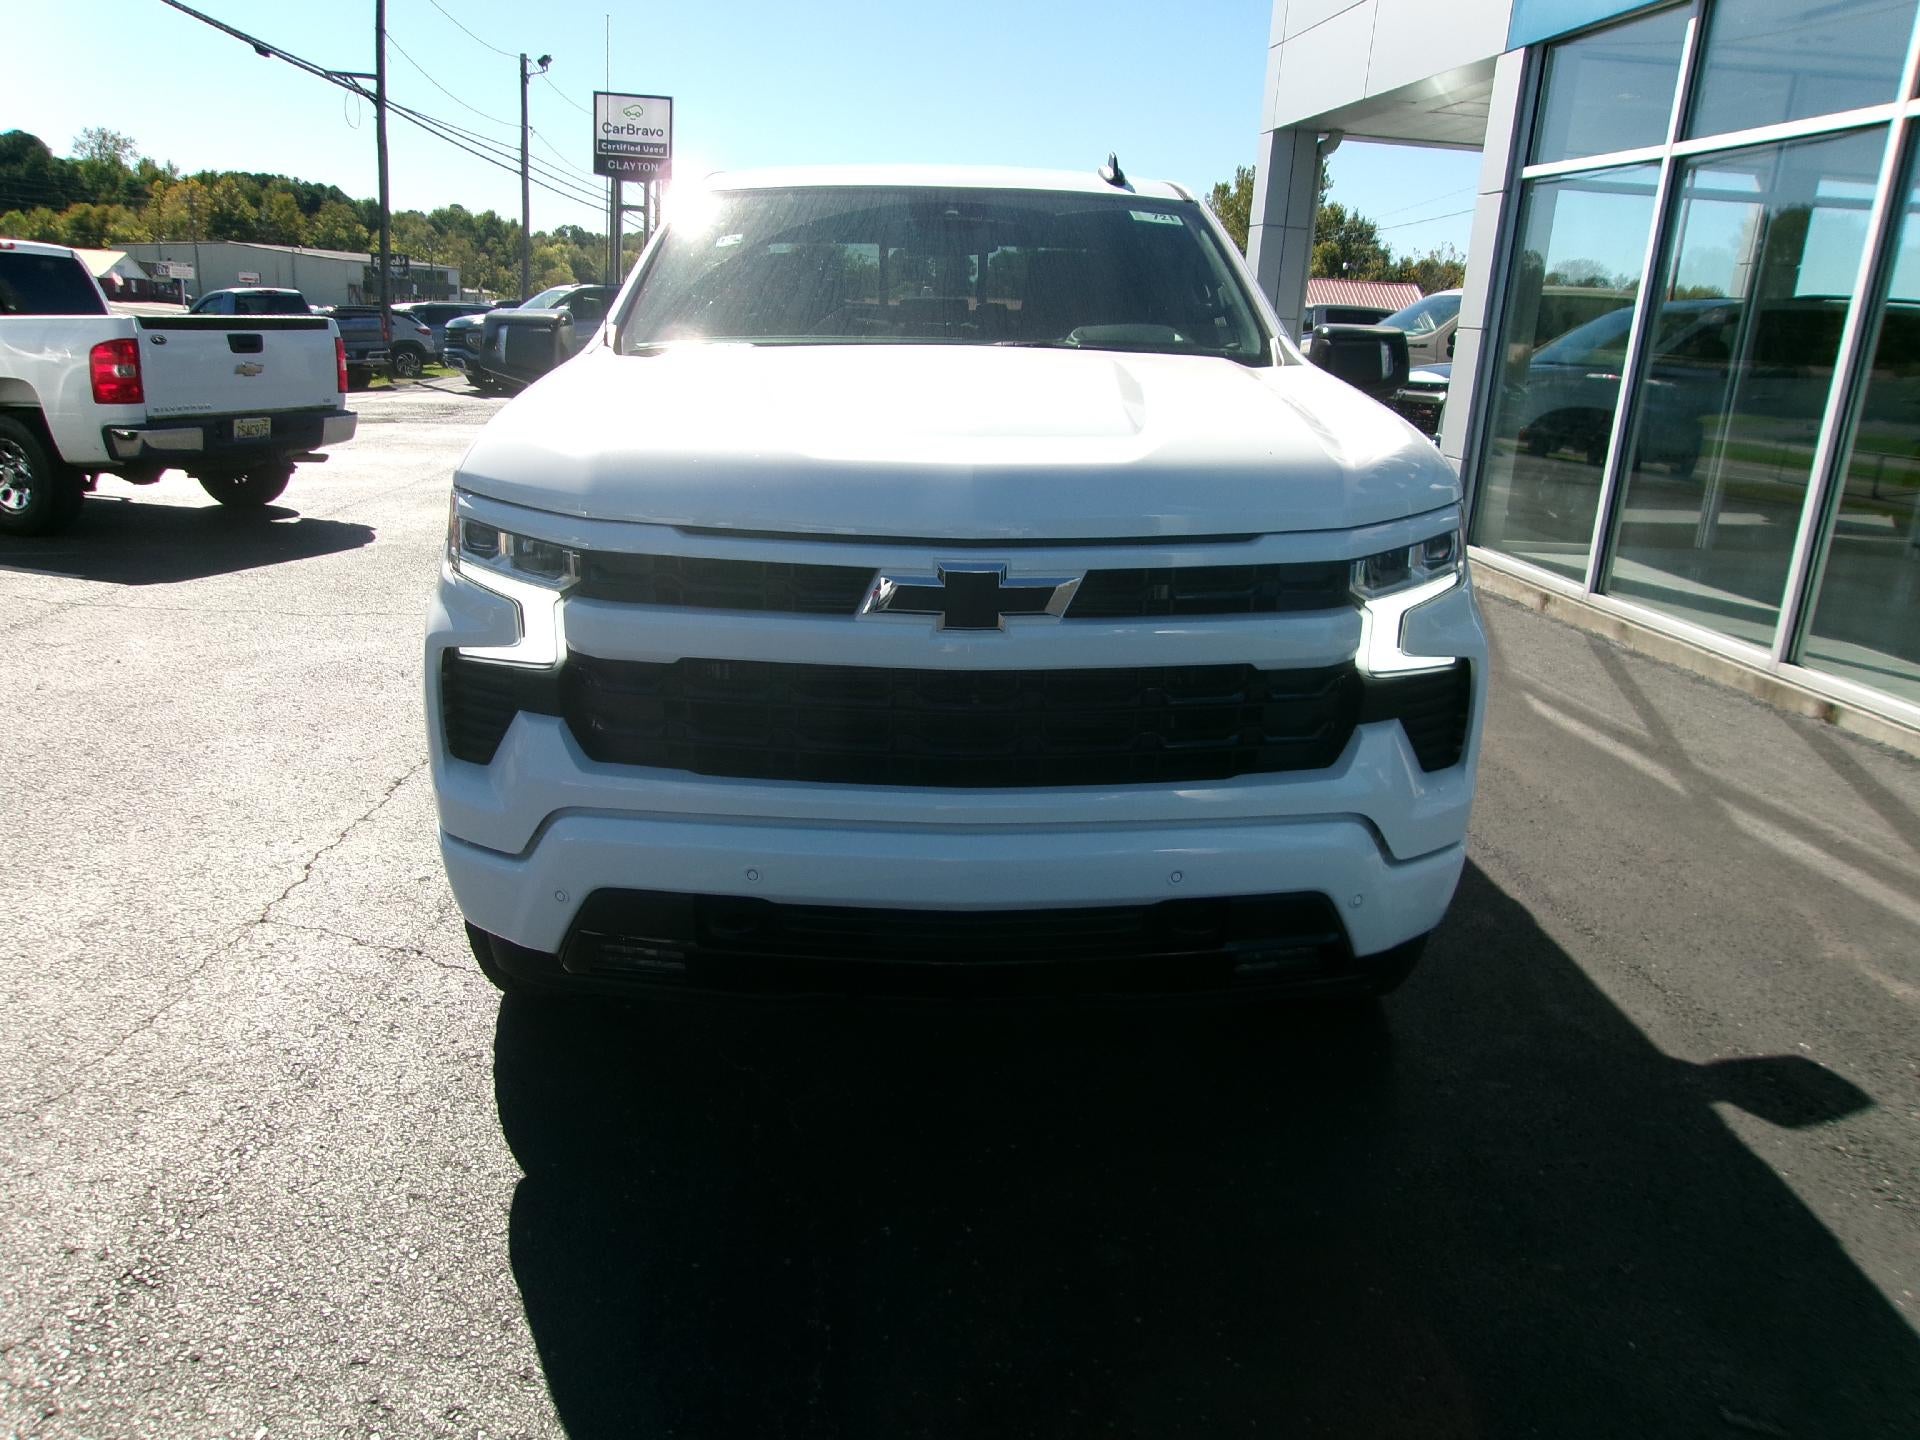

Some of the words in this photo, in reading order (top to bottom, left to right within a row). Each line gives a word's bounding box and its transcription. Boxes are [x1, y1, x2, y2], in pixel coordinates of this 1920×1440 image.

[602, 122, 664, 137] CarBravo
[601, 143, 641, 152] Certified
[643, 145, 664, 153] Used
[608, 160, 659, 172] CLAYTON
